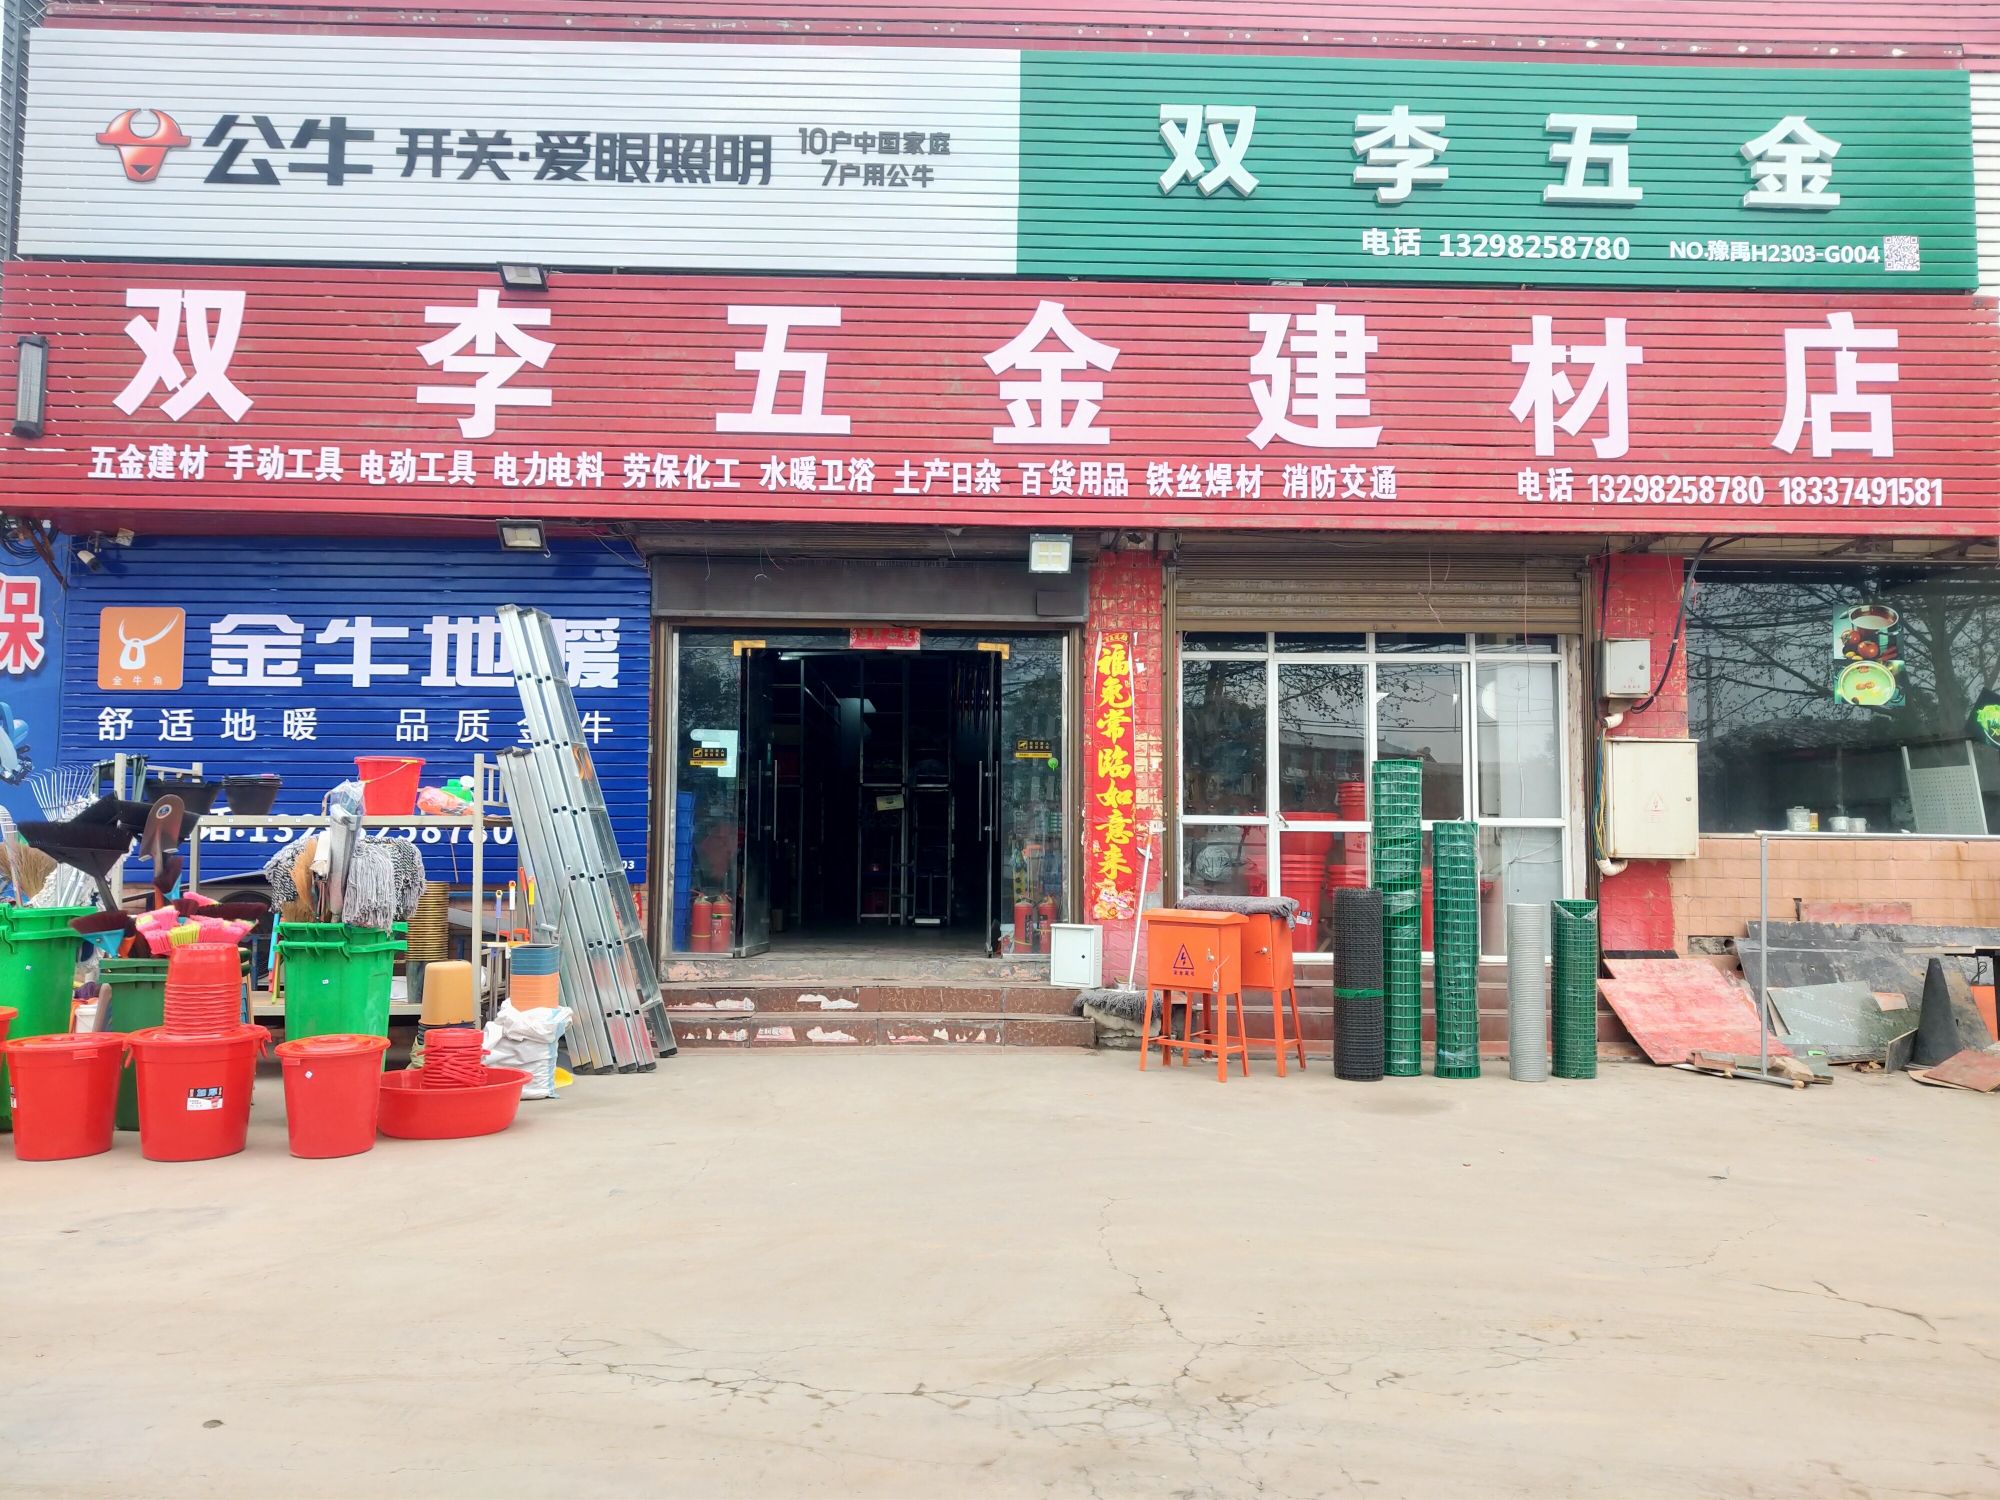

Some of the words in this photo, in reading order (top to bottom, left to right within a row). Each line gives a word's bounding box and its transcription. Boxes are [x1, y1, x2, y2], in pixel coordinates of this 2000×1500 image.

[202, 114, 374, 186] 公牛
[799, 128, 951, 155] 10户中国家庭
[1159, 104, 1842, 210] 双李五金
[821, 159, 935, 188] 7户用公牛
[1361, 227, 1422, 257] 电话
[1439, 233, 1630, 261] 13298258780
[112, 287, 1899, 459] 双李五金建材店
[88, 444, 208, 480] 五金建材
[225, 445, 344, 482] 手动工具
[360, 448, 476, 485] 电动工具
[494, 450, 605, 487] 电力电料
[622, 453, 740, 490] 劳保化工
[759, 455, 876, 492] 水暖卫浴
[893, 458, 1001, 494] 土产日杂
[1018, 460, 1129, 497] 百货用品
[1146, 461, 1264, 498] 铁丝焊材
[1282, 463, 1397, 500] 消防交通
[1517, 466, 1573, 502] 电话
[1587, 474, 1765, 505] 13298258780
[1778, 477, 1943, 507] 18337491581
[98, 706, 318, 743] 舒适地暖
